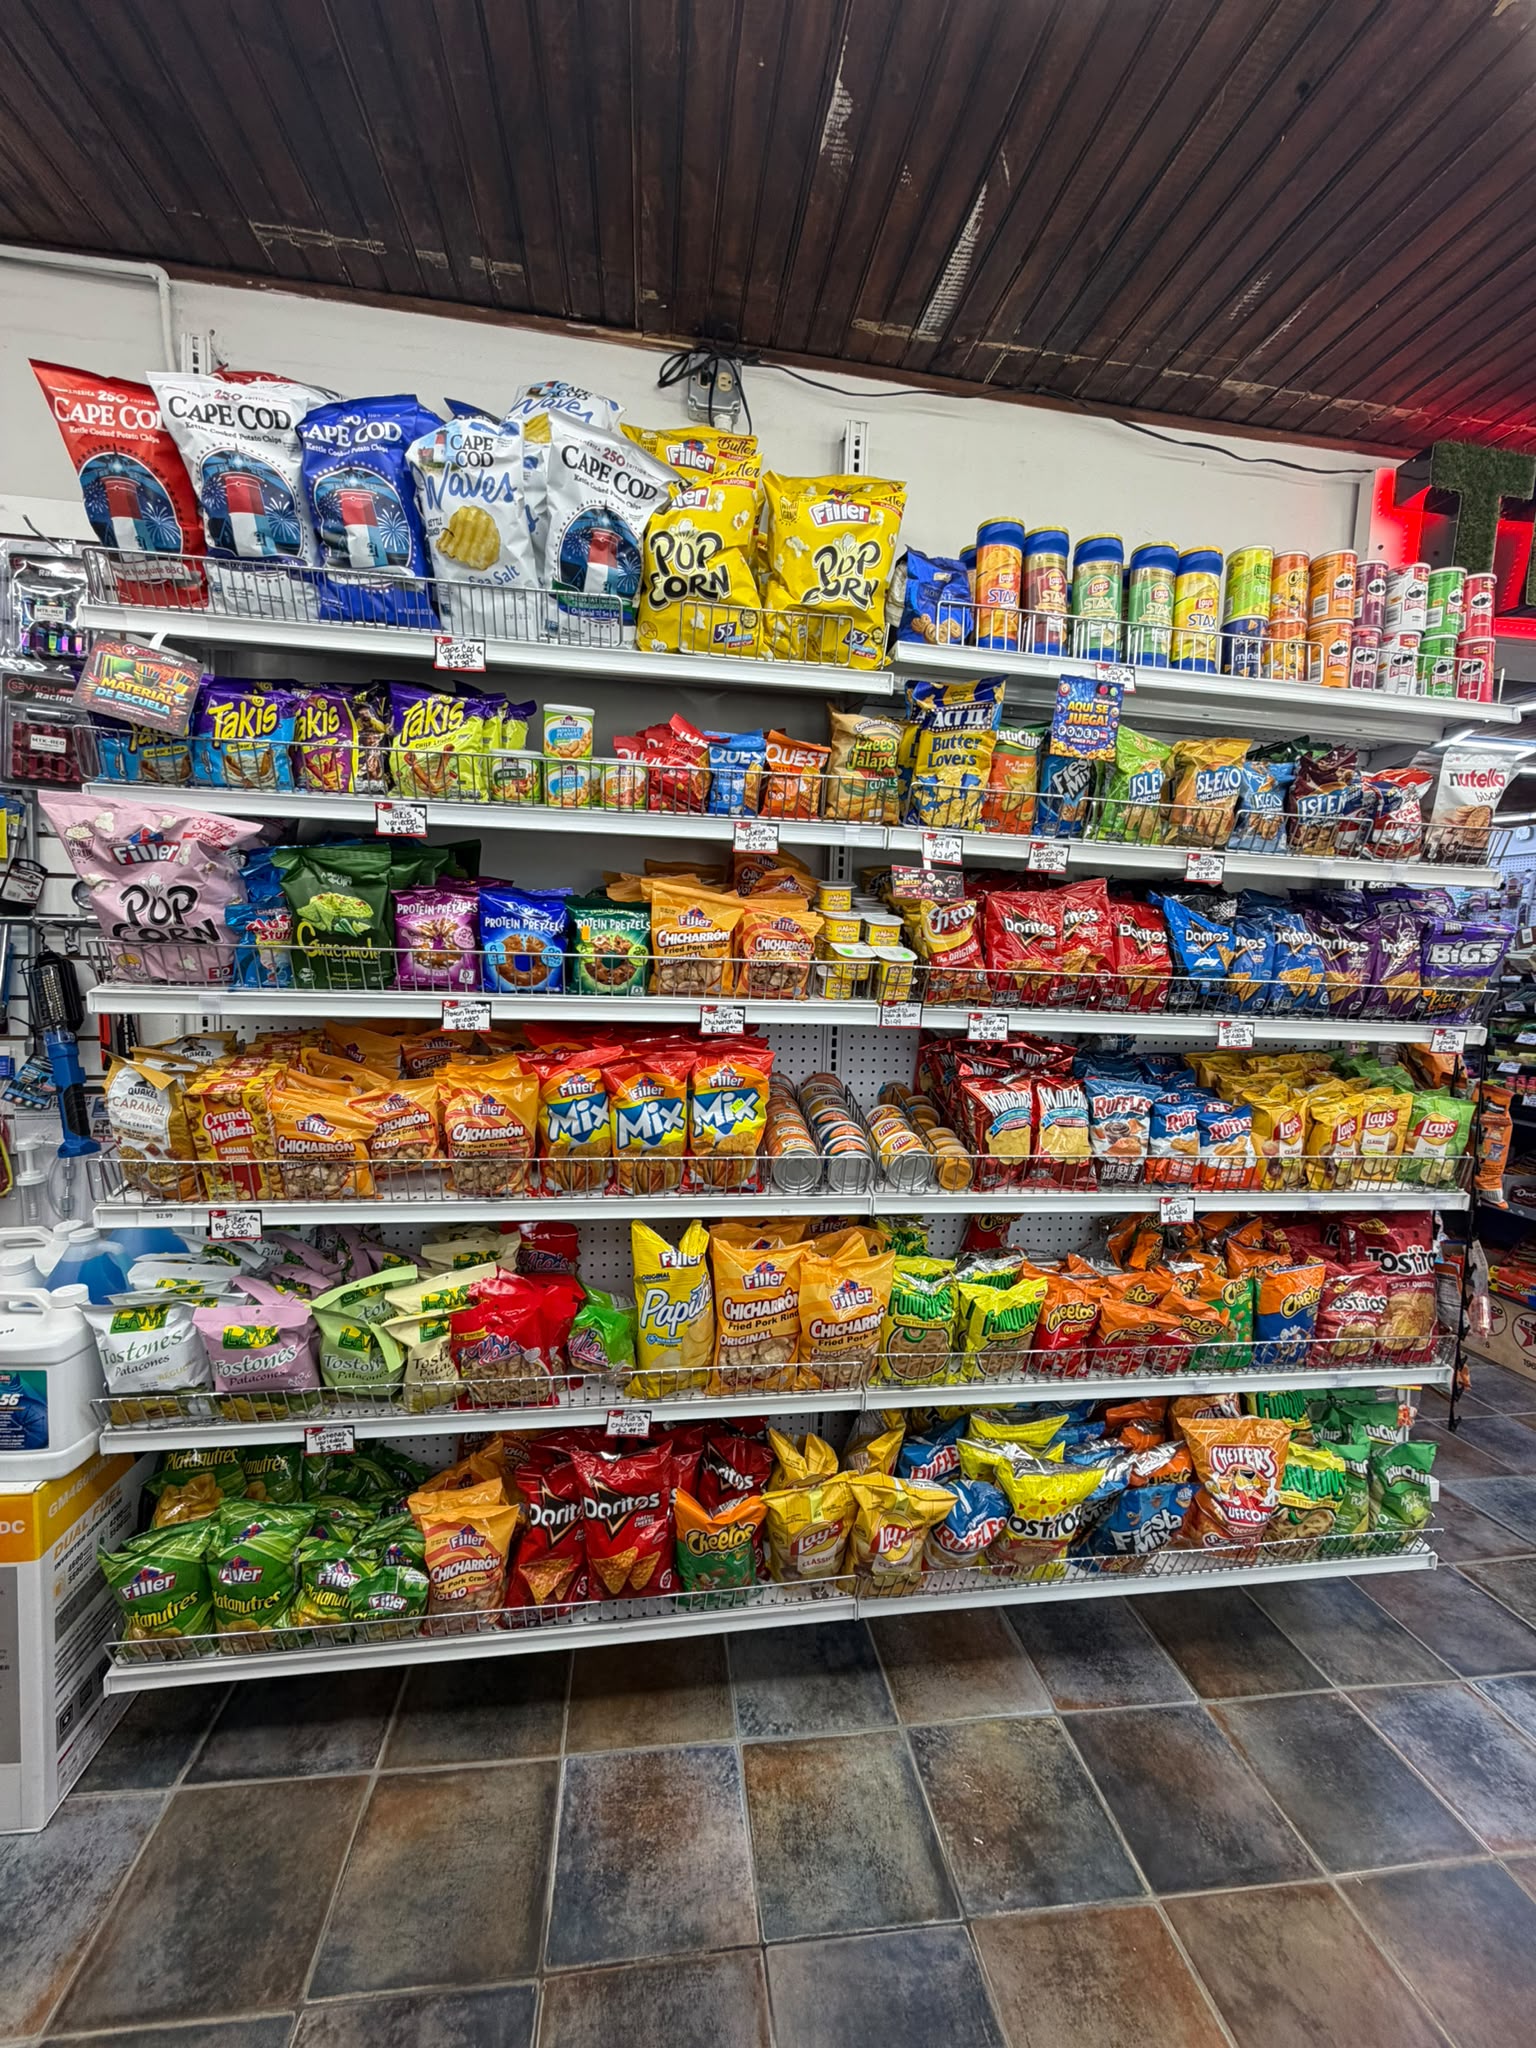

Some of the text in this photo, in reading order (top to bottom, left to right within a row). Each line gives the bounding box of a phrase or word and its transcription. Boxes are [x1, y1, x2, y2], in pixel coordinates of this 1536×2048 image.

[53, 396, 116, 427] CAPE
[168, 395, 292, 431] CAPE COD
[140, 433, 160, 444] Chips
[239, 433, 262, 443] Potato
[262, 435, 282, 444] Chips
[450, 434, 495, 452] CAPE
[717, 438, 757, 457] Butter
[455, 451, 495, 468] COD
[602, 447, 626, 467] 250
[667, 445, 716, 474] Filler
[561, 444, 658, 501] CAPE COD
[422, 461, 518, 512] Waves
[811, 502, 871, 525] Filler
[650, 530, 724, 578] POP
[814, 540, 881, 586] POP
[493, 564, 521, 586] Salt
[648, 564, 731, 611] CORN
[801, 576, 880, 610] CORN
[987, 588, 1018, 604] STAX
[1041, 590, 1066, 603] STAX
[1082, 597, 1114, 611] STAX
[1145, 603, 1171, 617] STAX
[1187, 613, 1217, 629] STAX
[35, 692, 74, 704] Racing
[95, 686, 116, 698] DE
[118, 693, 171, 716] ESCUELA
[100, 678, 175, 706] MATERIAL
[1095, 704, 1110, 714] SE
[208, 695, 278, 748] Takis
[400, 697, 465, 747] Takis
[933, 709, 985, 729] ACT II
[1065, 712, 1109, 727] JUEGA!
[1057, 725, 1100, 741] POWER
[932, 736, 983, 752] Butter
[765, 743, 829, 769] QUEST
[928, 752, 977, 769] Lovers
[1449, 768, 1505, 788] nutella
[390, 810, 412, 819] Takis
[112, 842, 180, 865] Filler
[119, 884, 199, 926] POP
[397, 902, 434, 915] PROTEIN
[485, 917, 565, 933] PROTEIN PRETZELS
[574, 918, 651, 932] PROTEIN PRETZELS
[678, 915, 712, 928] Filler
[771, 920, 801, 934] Filler
[928, 902, 976, 934] Fritos
[1003, 916, 1057, 938] Doritos
[112, 918, 223, 945] CORN
[657, 927, 731, 948] CHICHARRÓN
[1118, 923, 1168, 944] Doritos
[1185, 929, 1230, 943] Doritos
[664, 941, 728, 955] Fried Pork Rinds
[755, 936, 813, 952] CHICHARRÓN
[1312, 932, 1369, 953] Doritos
[948, 943, 979, 962] ORIGINAL
[712, 1011, 733, 1020] Filler
[559, 1081, 595, 1097] Filler
[710, 1076, 744, 1088] Filler
[127, 1085, 159, 1100] QUAKER
[631, 1086, 665, 1101] Filler
[112, 1096, 166, 1118] CARAMEL
[473, 1102, 506, 1116] Filler
[694, 1091, 760, 1137] Mix
[1092, 1096, 1151, 1119] RUFFLES
[203, 1107, 251, 1130] Crunch
[296, 1119, 336, 1136] Filler
[548, 1100, 610, 1143] Mix
[616, 1101, 686, 1150] Mix
[1364, 1109, 1396, 1130] Lay's
[1420, 1118, 1457, 1138] Lay's
[211, 1123, 255, 1146] Munch
[451, 1123, 524, 1142] CHICHARRÓN
[1279, 1119, 1300, 1140] Lay's
[1337, 1119, 1356, 1141] Lay's
[220, 1146, 250, 1155] CARAMEL
[278, 1136, 355, 1154] CHICHARRÓN
[155, 1212, 173, 1220] $2.99
[232, 1221, 253, 1231] Corn
[660, 1250, 703, 1269] Filler
[640, 1272, 671, 1282] ORIGINAL
[743, 1271, 785, 1290] Filler
[831, 1287, 873, 1310] Filler
[728, 1318, 778, 1331] Fried Pork
[1046, 1302, 1098, 1334] Cheetos
[101, 1329, 183, 1365] Tostones
[719, 1329, 772, 1347] ORIGINAL
[818, 1333, 870, 1347] Fried Pork
[114, 1354, 171, 1377] Patacones
[229, 1369, 287, 1386] Patacones
[337, 1368, 391, 1383] Patacones
[1212, 1446, 1277, 1478] CHESTER'S
[584, 1491, 660, 1519] Doritos
[53, 1518, 89, 1561] DUAL
[92, 1485, 122, 1521] FUEL
[634, 1518, 655, 1527] CHEESE
[1111, 1508, 1184, 1551] Fiesta
[449, 1534, 486, 1550] Filler
[687, 1523, 756, 1557] Cheetos
[799, 1522, 842, 1554] Lay's
[935, 1516, 1008, 1552] RUFFLES
[1135, 1529, 1173, 1552] Mix
[431, 1555, 501, 1585] CHICHARRÓN
[801, 1555, 835, 1567] CLASSIC
[219, 1567, 263, 1584] Filler
[316, 1572, 359, 1588] Filler
[121, 1574, 175, 1601] Filler
[368, 1593, 408, 1611] Filler
